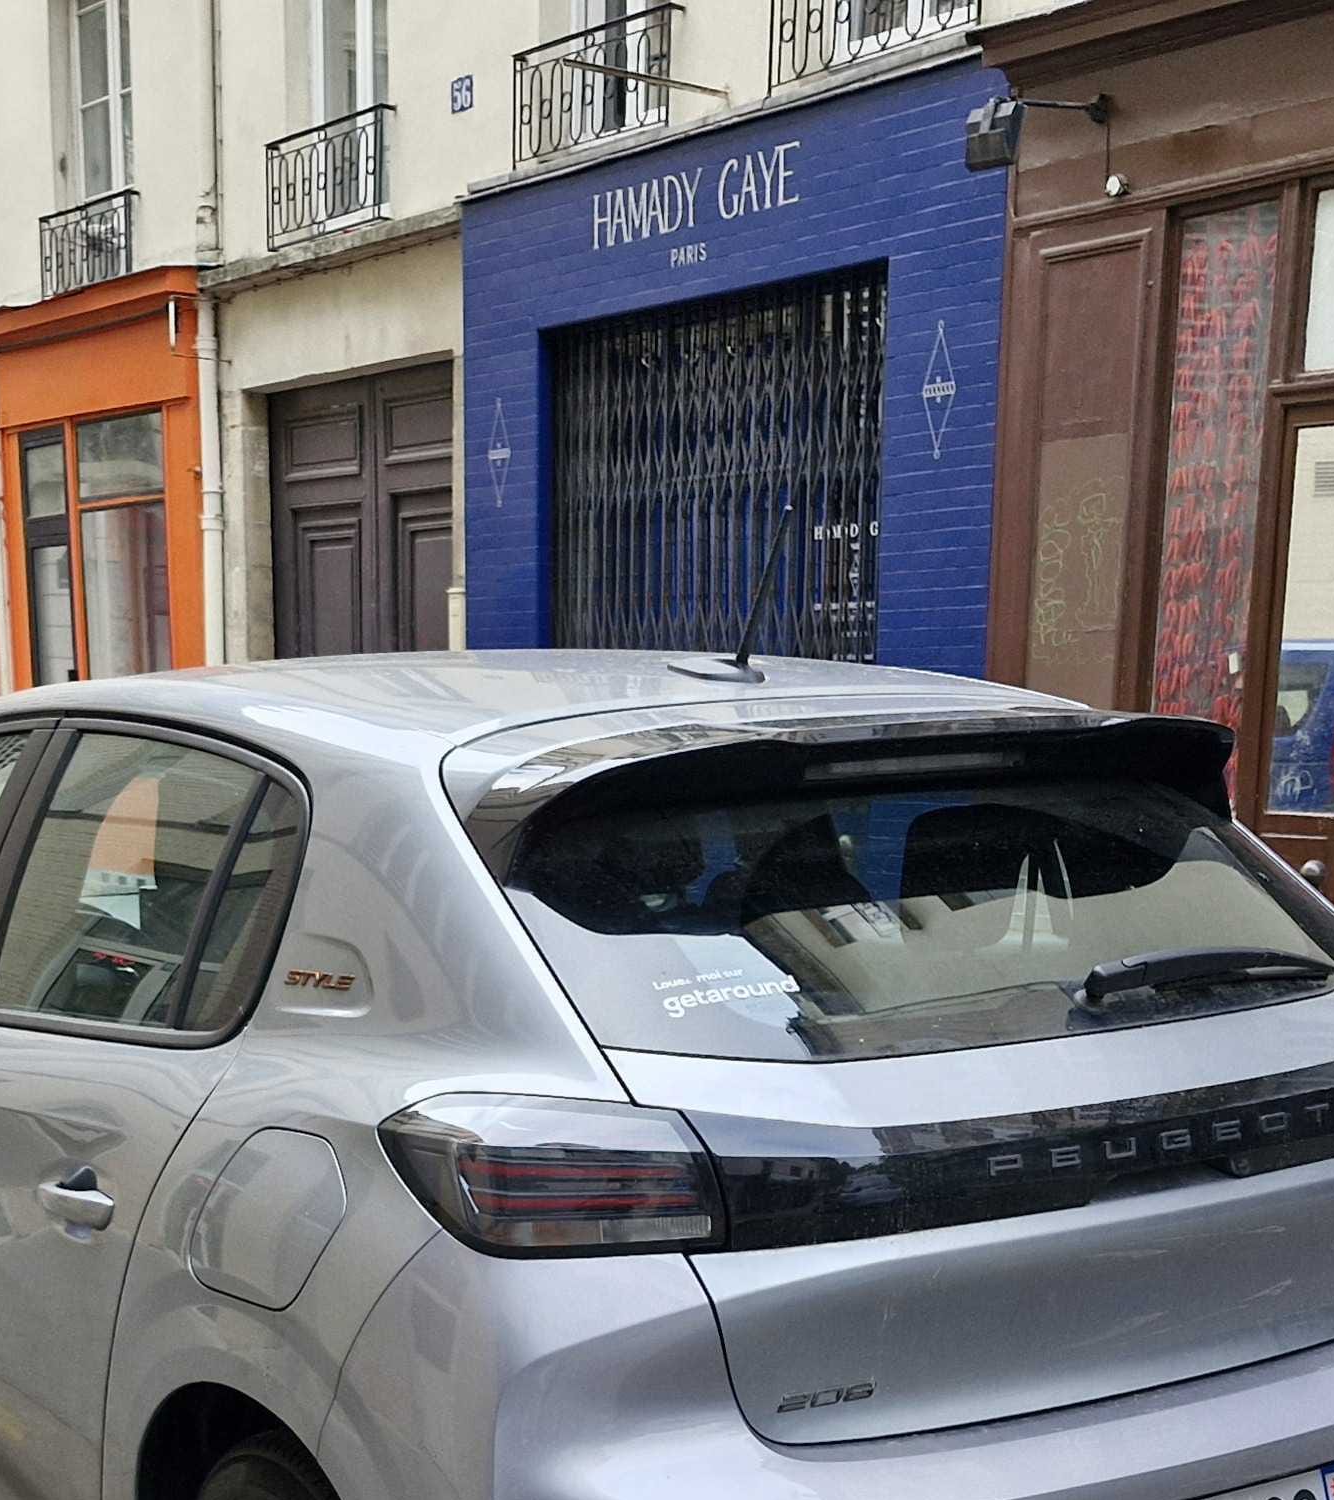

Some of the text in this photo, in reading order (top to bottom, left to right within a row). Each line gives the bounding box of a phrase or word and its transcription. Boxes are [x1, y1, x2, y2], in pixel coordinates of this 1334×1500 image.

[453, 79, 471, 110] 56
[593, 140, 801, 249] HAMADY GAYE
[670, 243, 708, 268] PARIS
[284, 969, 356, 991] STYLE
[663, 974, 801, 1018] getaround
[988, 1103, 1330, 1176] PEUGEOT
[777, 1379, 877, 1413] 208
